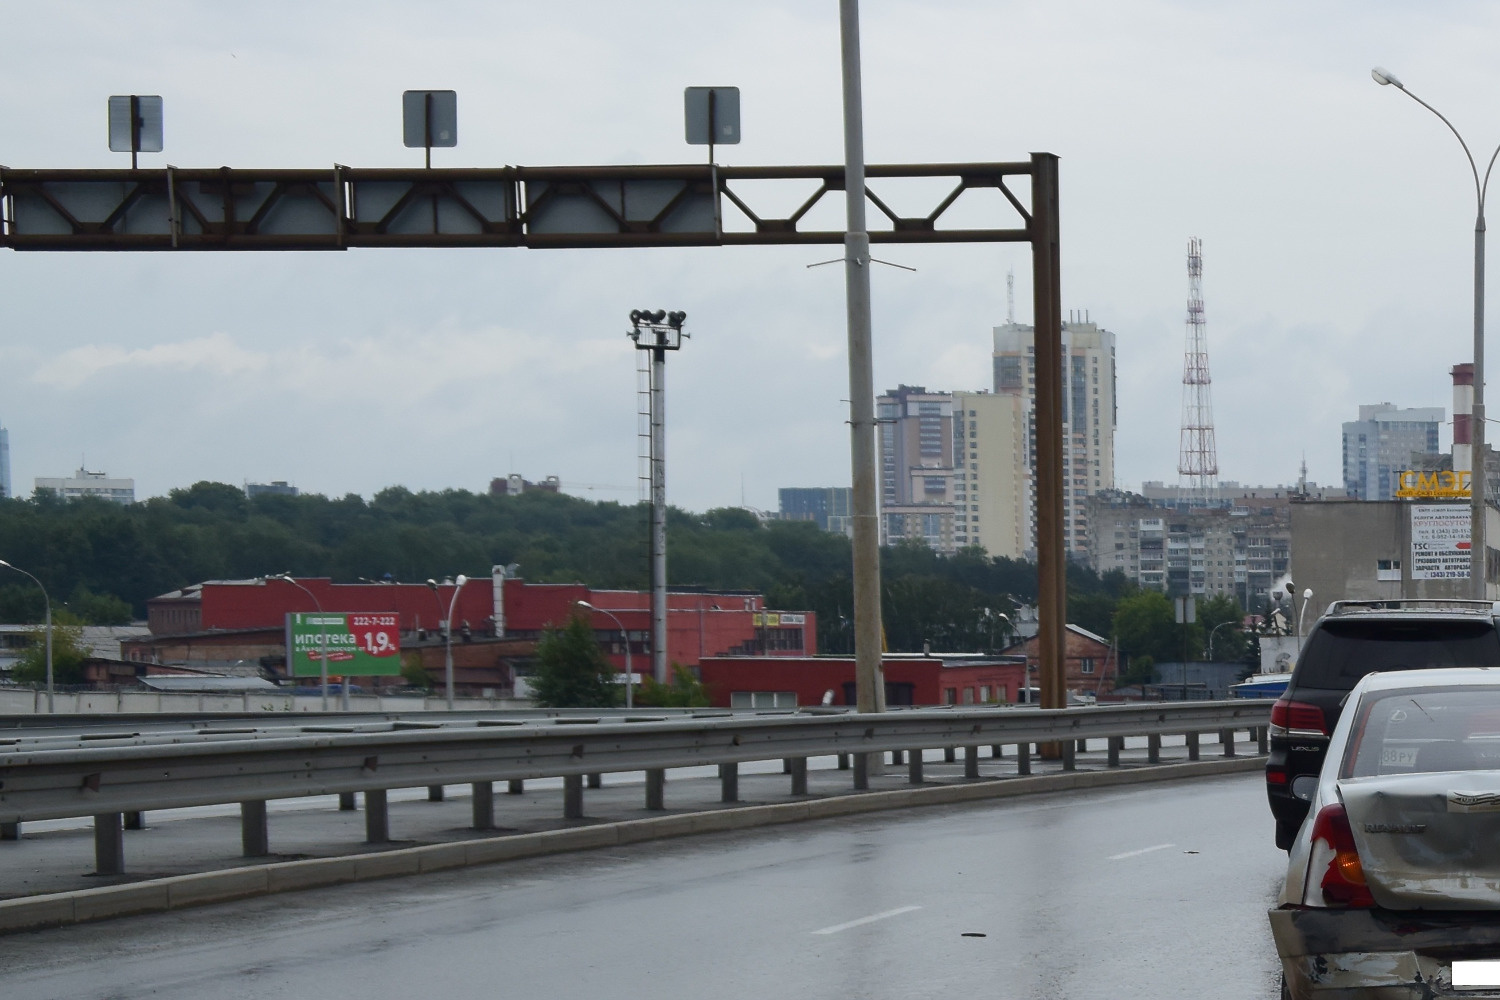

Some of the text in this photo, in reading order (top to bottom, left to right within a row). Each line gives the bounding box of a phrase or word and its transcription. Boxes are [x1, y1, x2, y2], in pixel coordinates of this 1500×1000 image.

[1413, 542, 1428, 550] TSC
[353, 616, 396, 626] 222-7-222
[294, 633, 357, 645] ипотека
